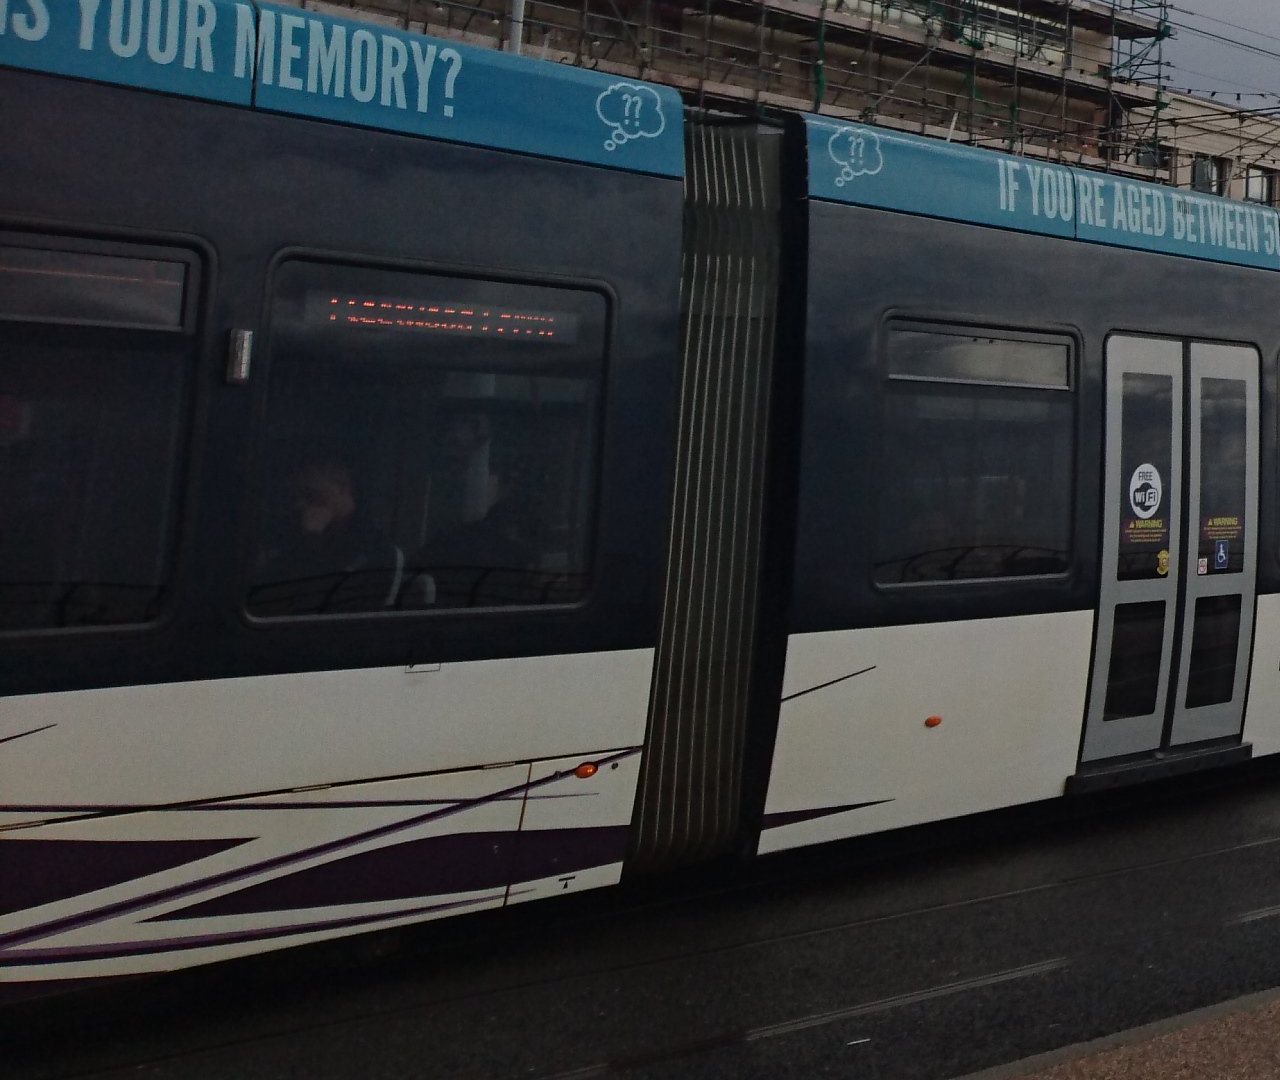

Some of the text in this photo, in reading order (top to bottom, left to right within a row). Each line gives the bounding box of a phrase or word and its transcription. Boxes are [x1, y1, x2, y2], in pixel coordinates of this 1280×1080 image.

[233, 2, 463, 119] MEMORY?
[996, 157, 1020, 213] IF
[1112, 181, 1167, 238] AGED
[1170, 192, 1260, 254] BETWEEN
[1138, 471, 1153, 481] FREE
[1135, 520, 1163, 529] WARNING
